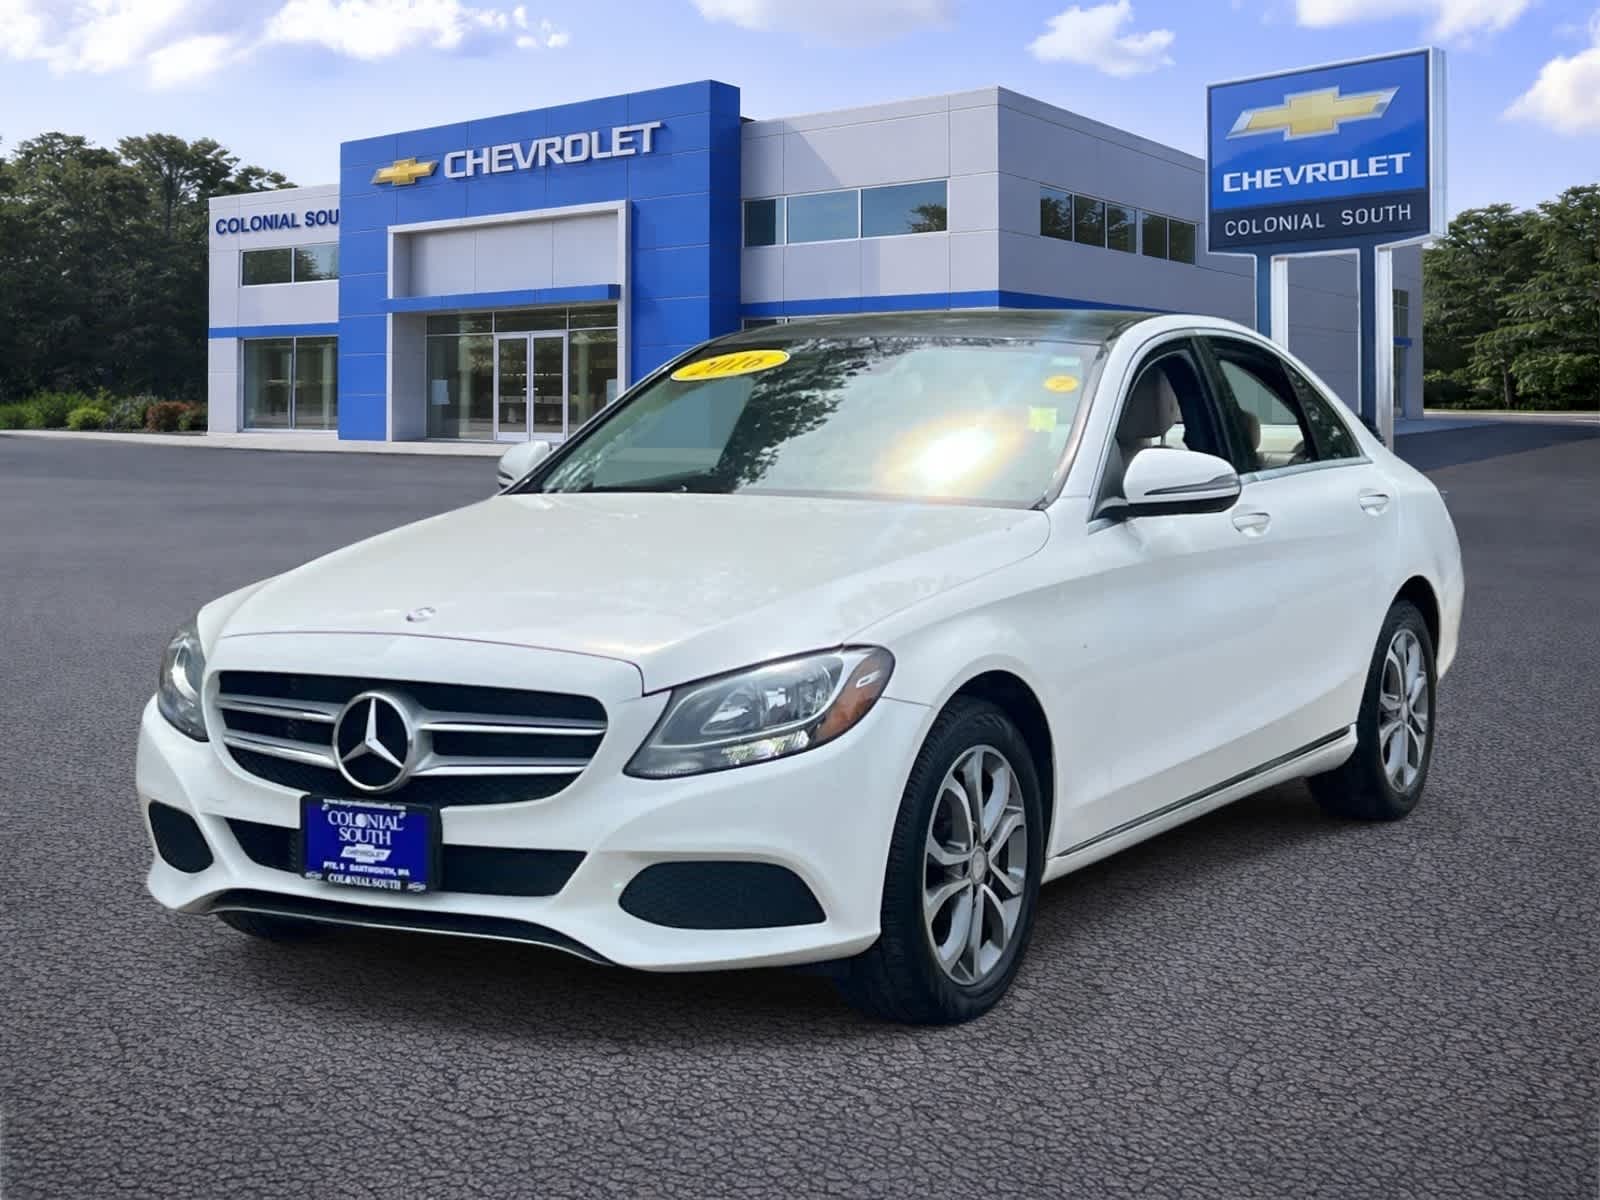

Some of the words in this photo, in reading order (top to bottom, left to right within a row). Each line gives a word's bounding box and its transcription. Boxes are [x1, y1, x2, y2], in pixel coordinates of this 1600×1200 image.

[444, 121, 662, 179] CHEVROLET
[1222, 152, 1412, 192] CHEVROLET
[216, 213, 301, 235] COLONIAL
[1225, 212, 1326, 237] COLONIAL
[1341, 203, 1412, 226] SOUTH
[327, 810, 404, 831] COLONIAL
[339, 827, 392, 846] SOUTH
